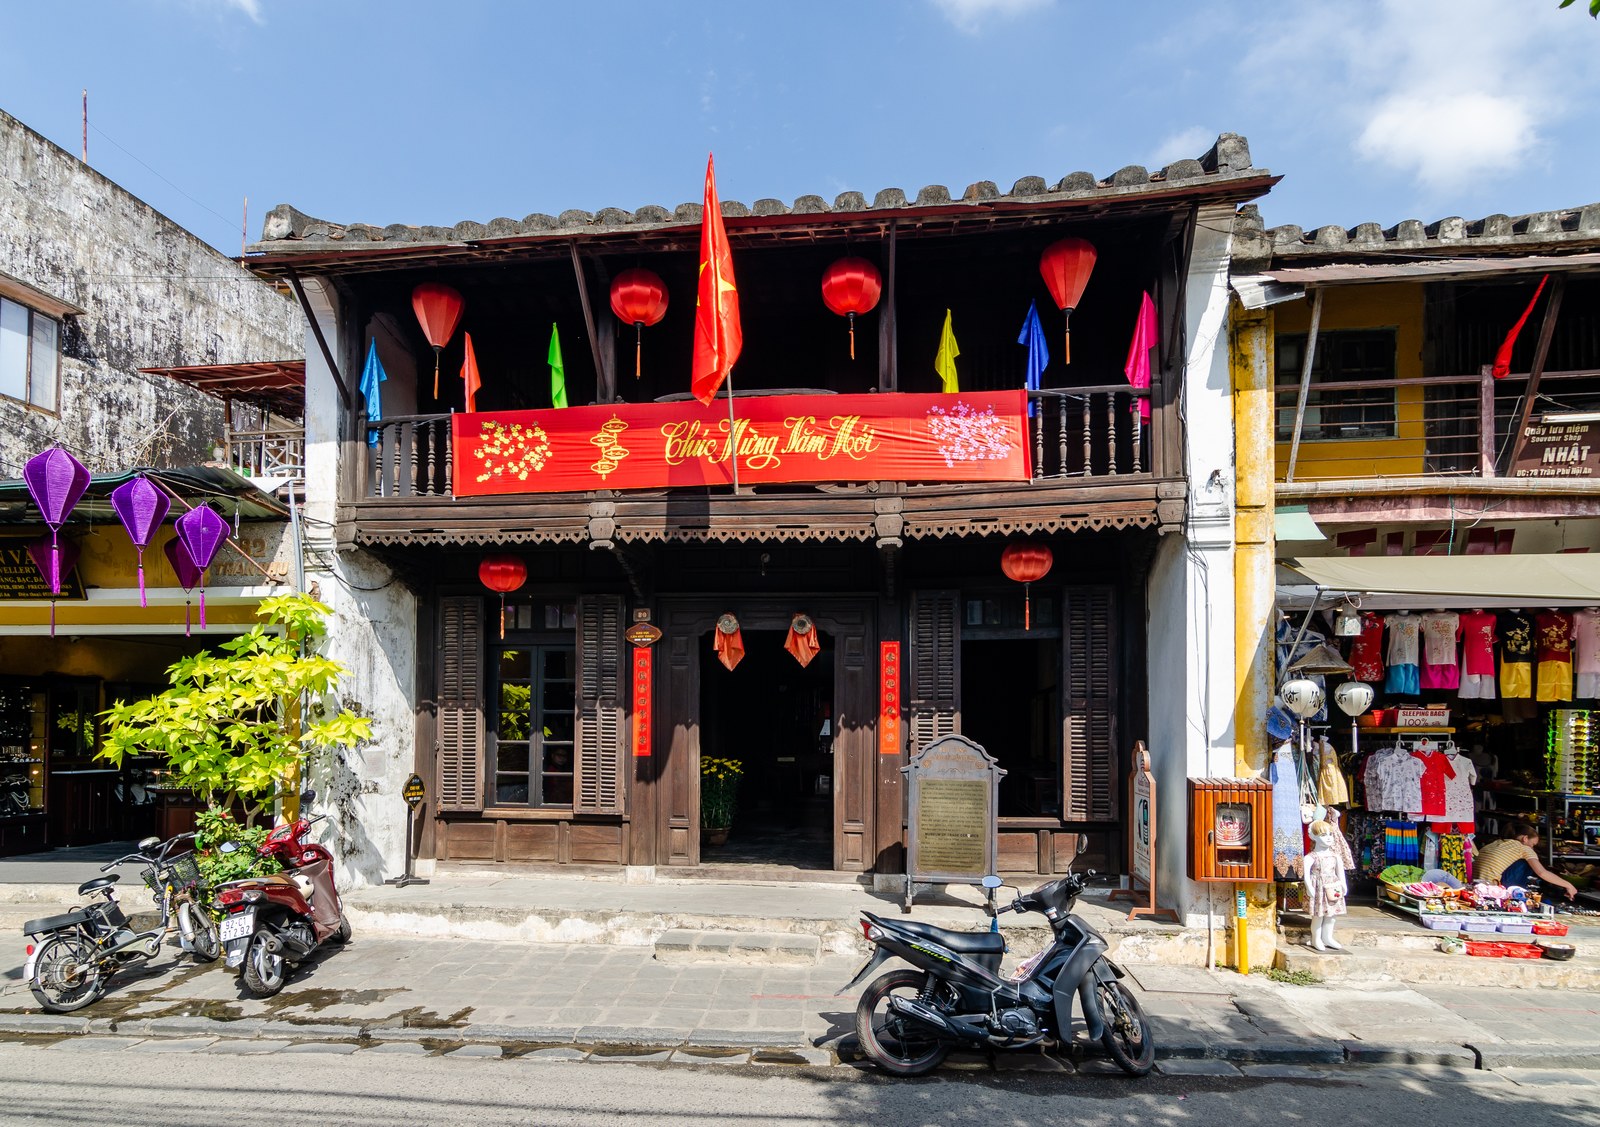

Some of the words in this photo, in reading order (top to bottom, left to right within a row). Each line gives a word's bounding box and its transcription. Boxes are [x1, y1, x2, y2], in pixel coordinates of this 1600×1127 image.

[660, 419, 718, 466] Chúc
[708, 418, 781, 469] Mừng
[781, 416, 828, 455] Năm
[817, 415, 881, 461] Mới
[1542, 443, 1591, 465] NHẬT
[1404, 718, 1429, 727] 100%
